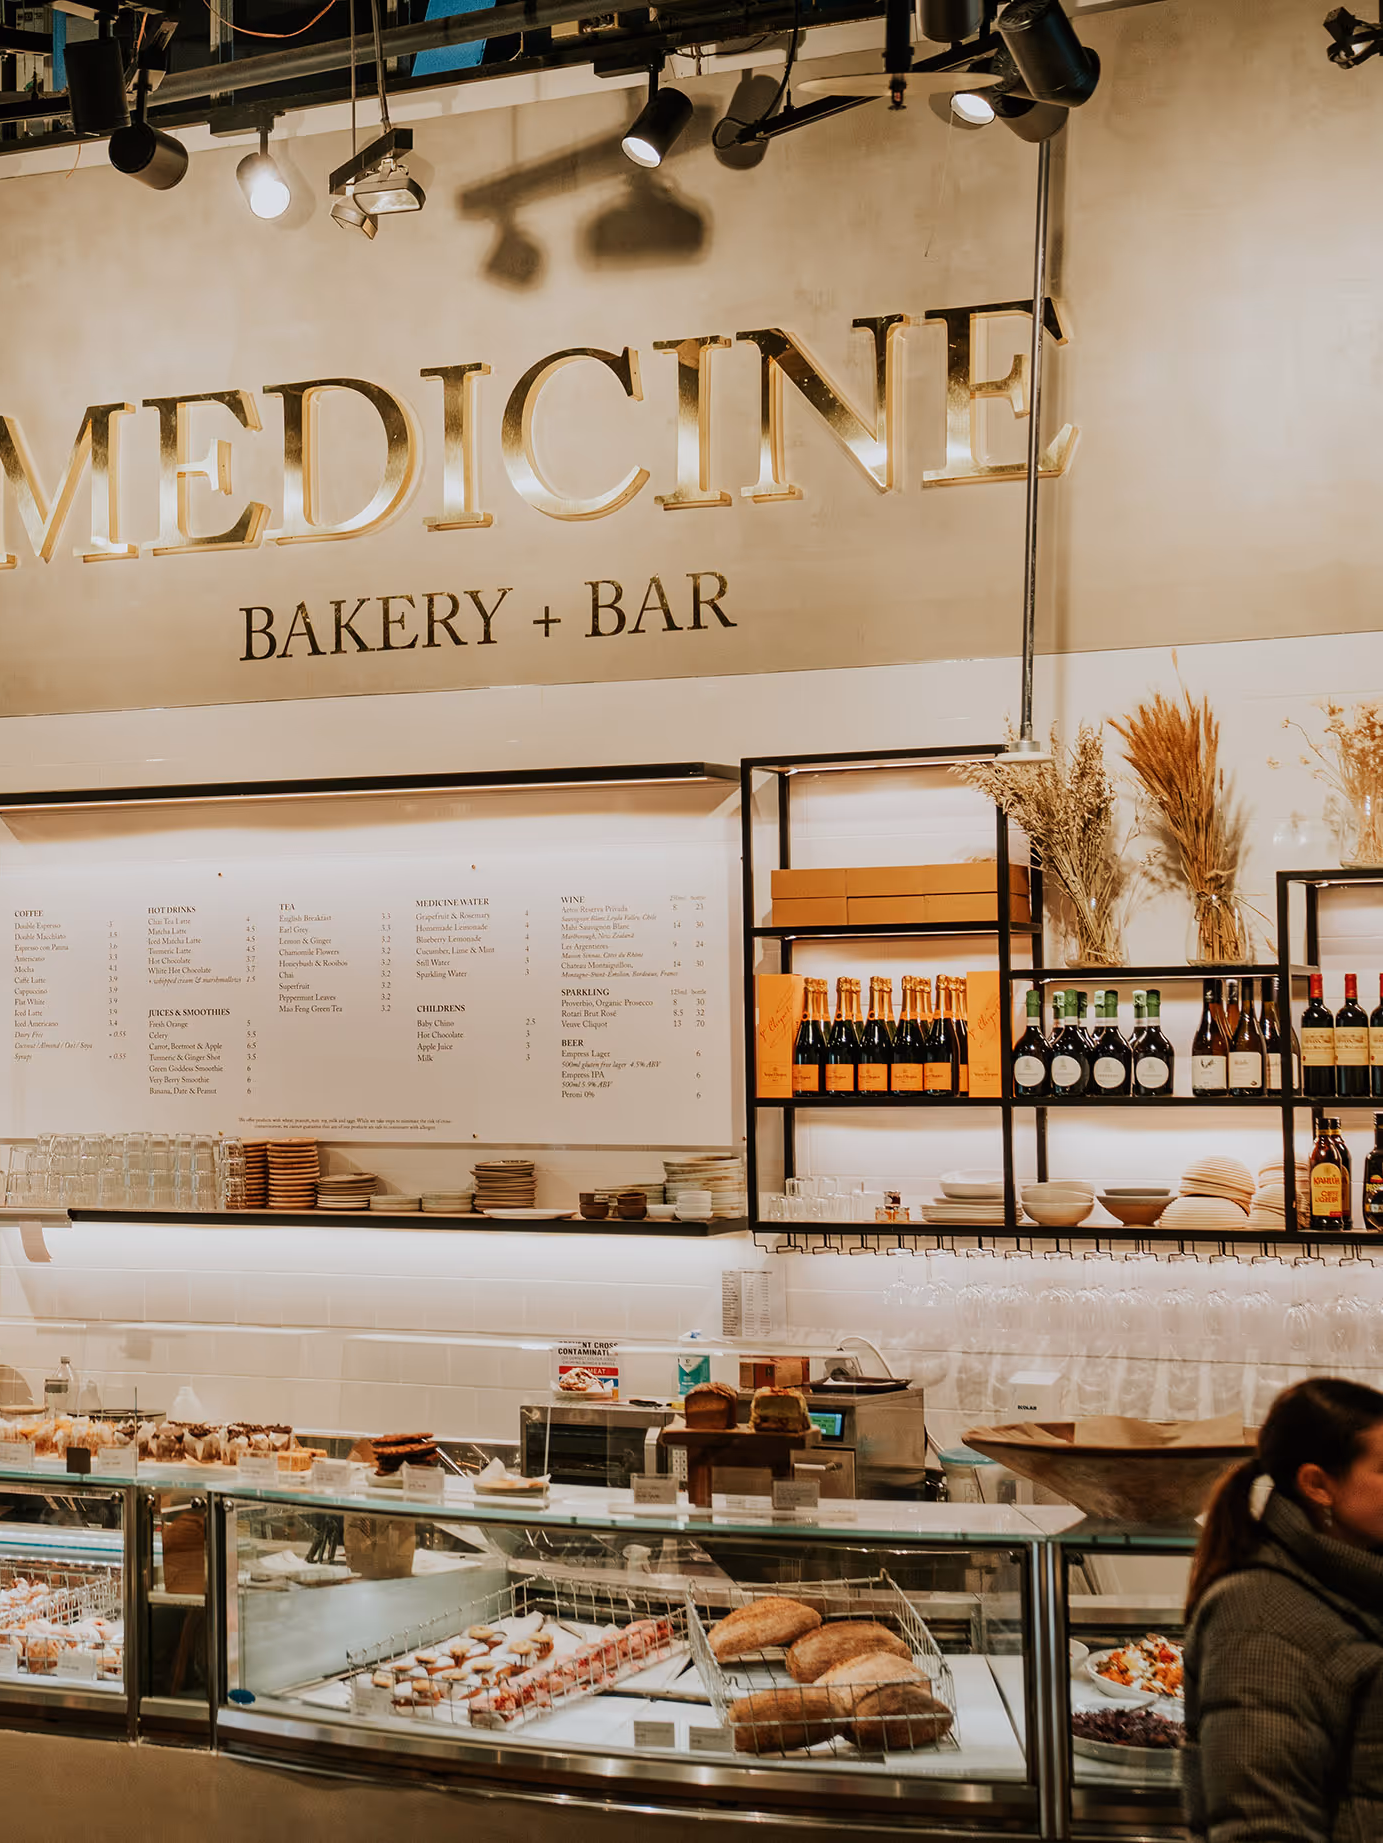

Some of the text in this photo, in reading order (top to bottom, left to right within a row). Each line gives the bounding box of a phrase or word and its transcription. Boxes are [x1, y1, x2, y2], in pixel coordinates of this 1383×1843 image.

[239, 571, 737, 661] BAKERY + BAR
[415, 898, 490, 907] MEDICINE WATER
[415, 913, 449, 922] Grapefruit
[459, 913, 490, 921] Rosemary
[293, 926, 308, 934] Grey
[310, 937, 332, 946] Ginger
[416, 936, 446, 944] Blueberry
[279, 960, 313, 969] Honeybush
[416, 971, 446, 980] Sparkling
[279, 983, 310, 991] Superfruit
[14, 988, 48, 996] Cappuccino
[279, 994, 313, 1003] Peppermint
[596, 1000, 622, 1008] Organic
[148, 1009, 174, 1018] JUICES
[183, 1008, 231, 1016] SMOOTHIES
[294, 1005, 310, 1014] Feng
[417, 1005, 465, 1013] CHILDRENS
[166, 1021, 188, 1029] Orange
[417, 1020, 433, 1028] Baby
[149, 1032, 168, 1040] Celery
[205, 1043, 222, 1051] Apple
[417, 1043, 453, 1052] Apple Juice
[184, 1054, 205, 1062] Ginger
[562, 1050, 610, 1058] Empress Lager
[582, 1061, 599, 1069] gluten
[613, 1061, 626, 1069] lager
[562, 1071, 589, 1079] Empress
[149, 1077, 163, 1085] Very
[164, 1076, 180, 1084] Berry
[558, 1348, 610, 1356] CONTAMINATI
